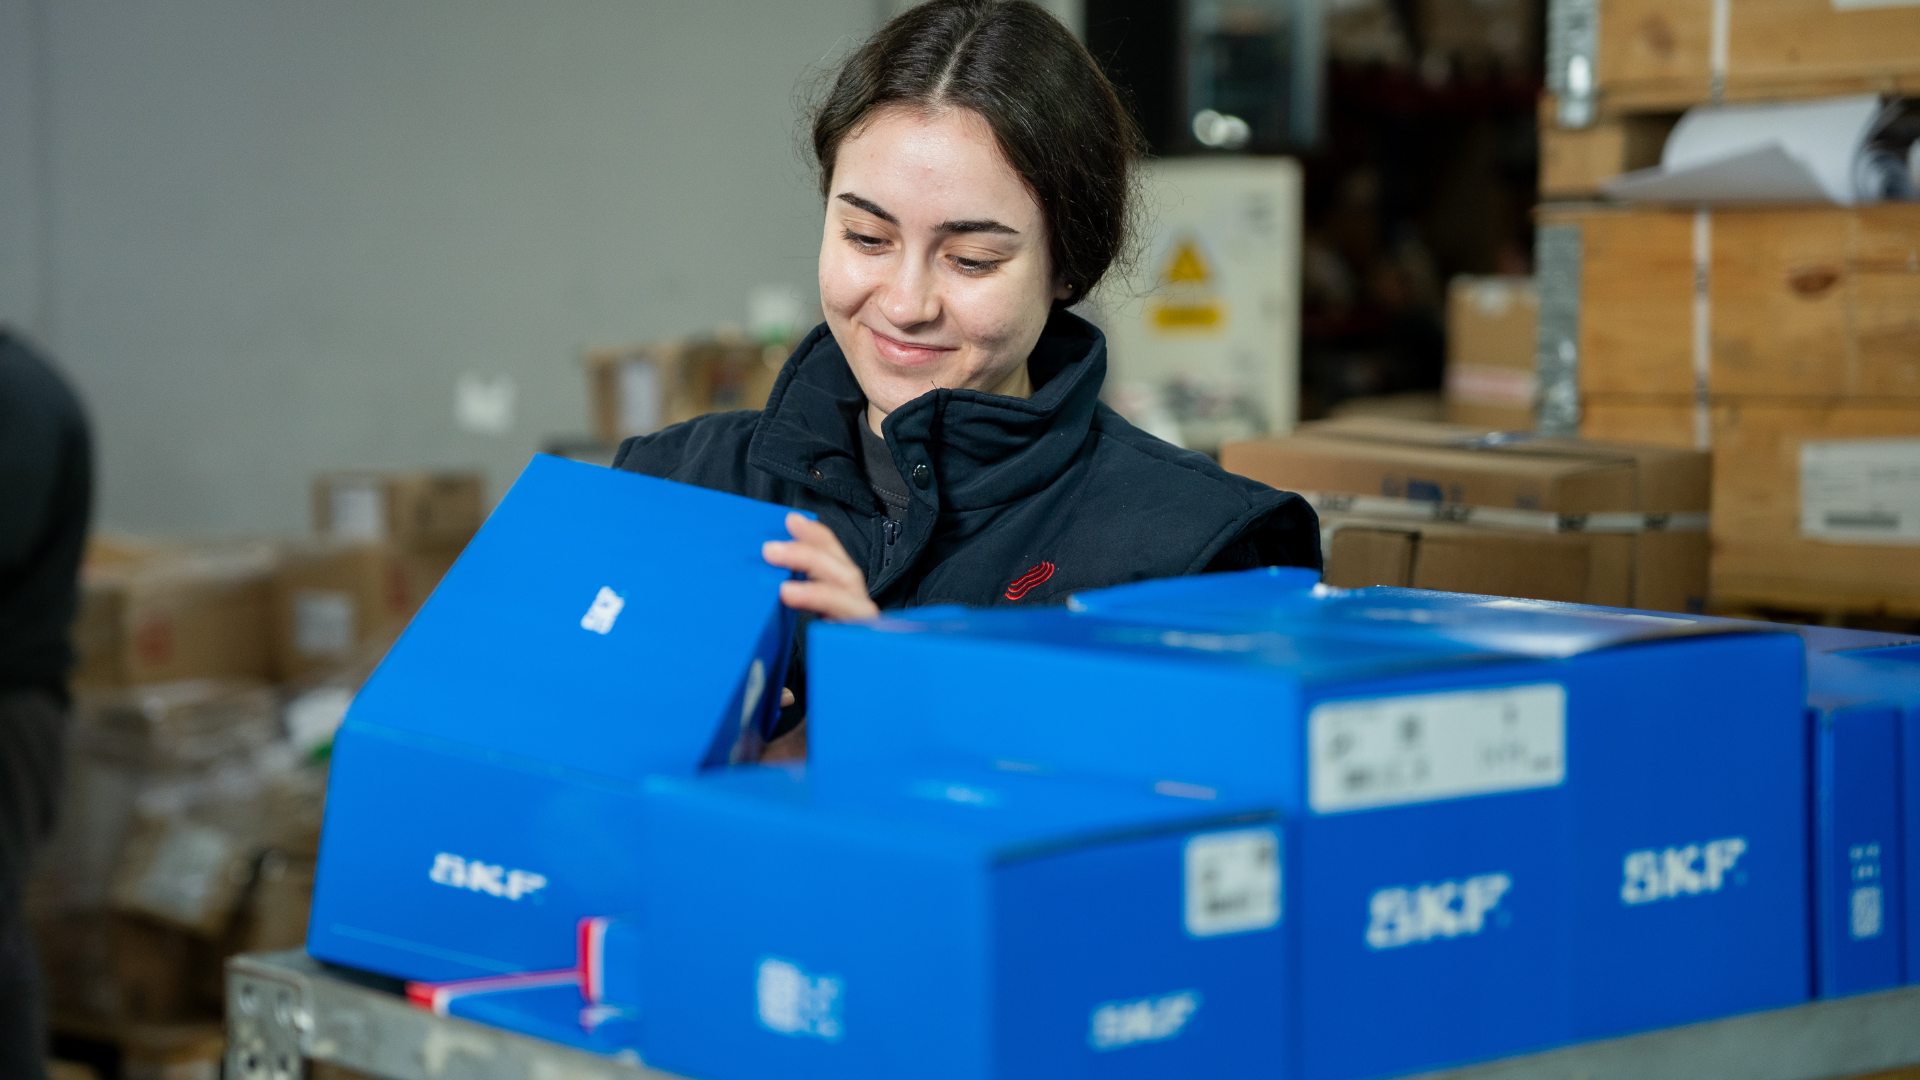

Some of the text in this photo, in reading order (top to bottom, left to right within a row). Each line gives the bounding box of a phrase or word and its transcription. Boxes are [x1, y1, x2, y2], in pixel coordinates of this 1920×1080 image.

[428, 852, 547, 901] SKF
[1620, 836, 1746, 905] SKF
[1365, 872, 1511, 950] SKF
